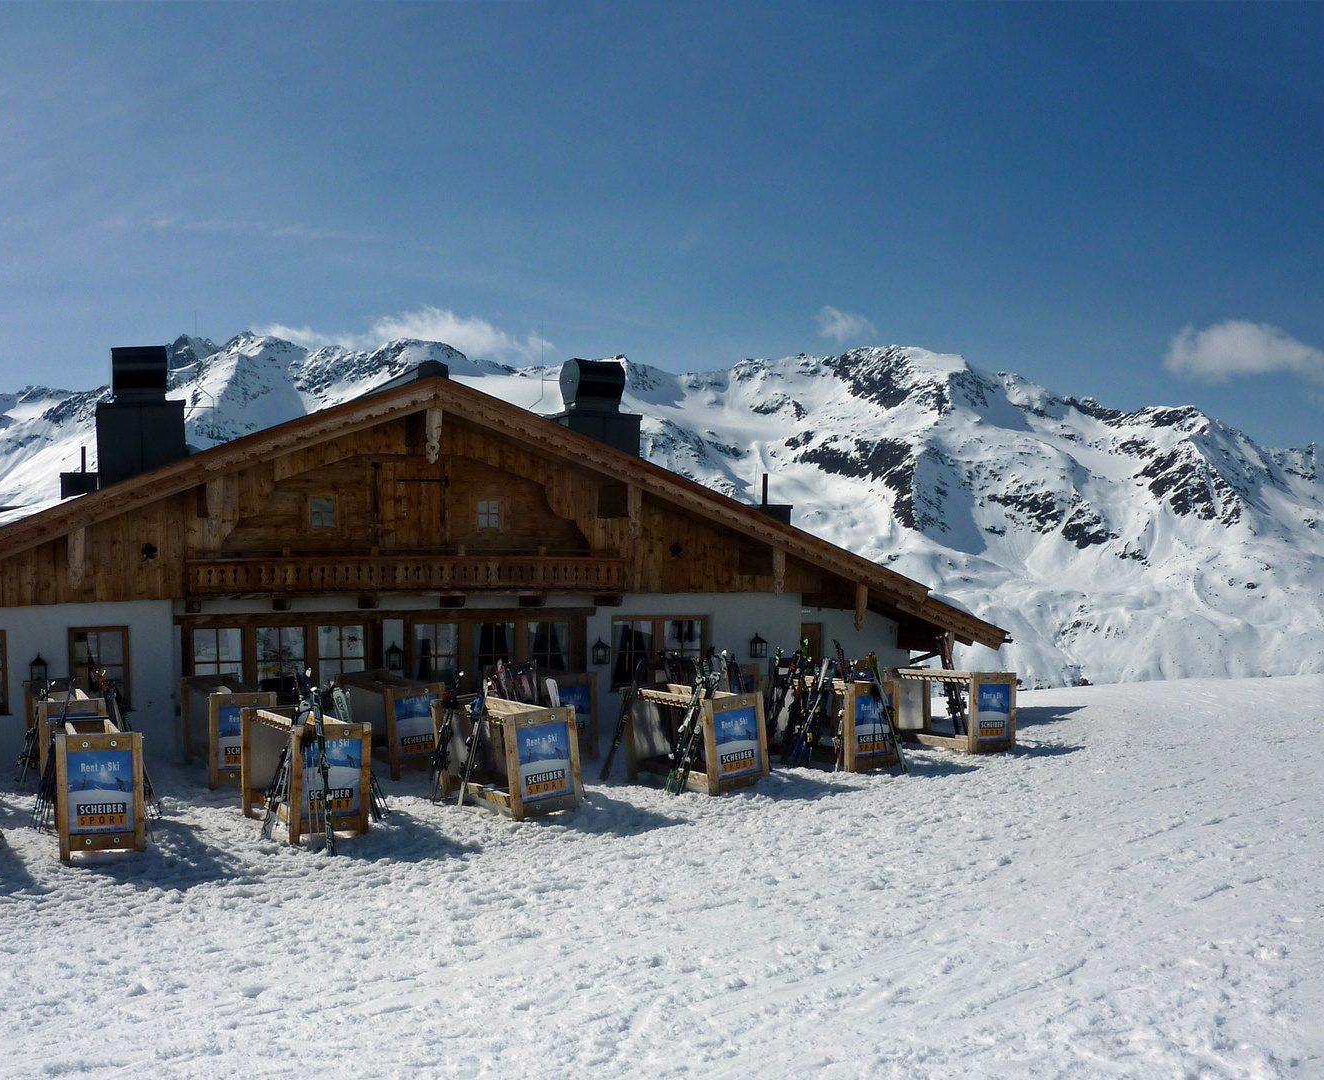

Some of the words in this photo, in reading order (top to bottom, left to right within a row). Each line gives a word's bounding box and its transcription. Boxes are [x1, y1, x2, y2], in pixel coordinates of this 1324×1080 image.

[402, 697, 415, 705] Rent
[228, 714, 240, 723] Ren
[721, 719, 734, 730] Rent
[739, 716, 749, 726] Ski
[980, 721, 1004, 729] SCHEIBER
[980, 728, 1004, 736] SPORT
[338, 738, 350, 748] Ski
[403, 734, 434, 745] SCHEIBER
[526, 735, 541, 747] Rent
[547, 733, 558, 744] Ski
[403, 742, 434, 753] SPORT
[722, 750, 753, 763] SCHEIBER
[80, 762, 98, 773] Rent
[107, 761, 120, 772] Ski
[723, 760, 753, 772] SPORT
[527, 770, 563, 785] SCHEIBER
[528, 780, 563, 794] SPORT
[79, 804, 124, 815] SCHEIBER
[80, 815, 124, 826] SPORT
